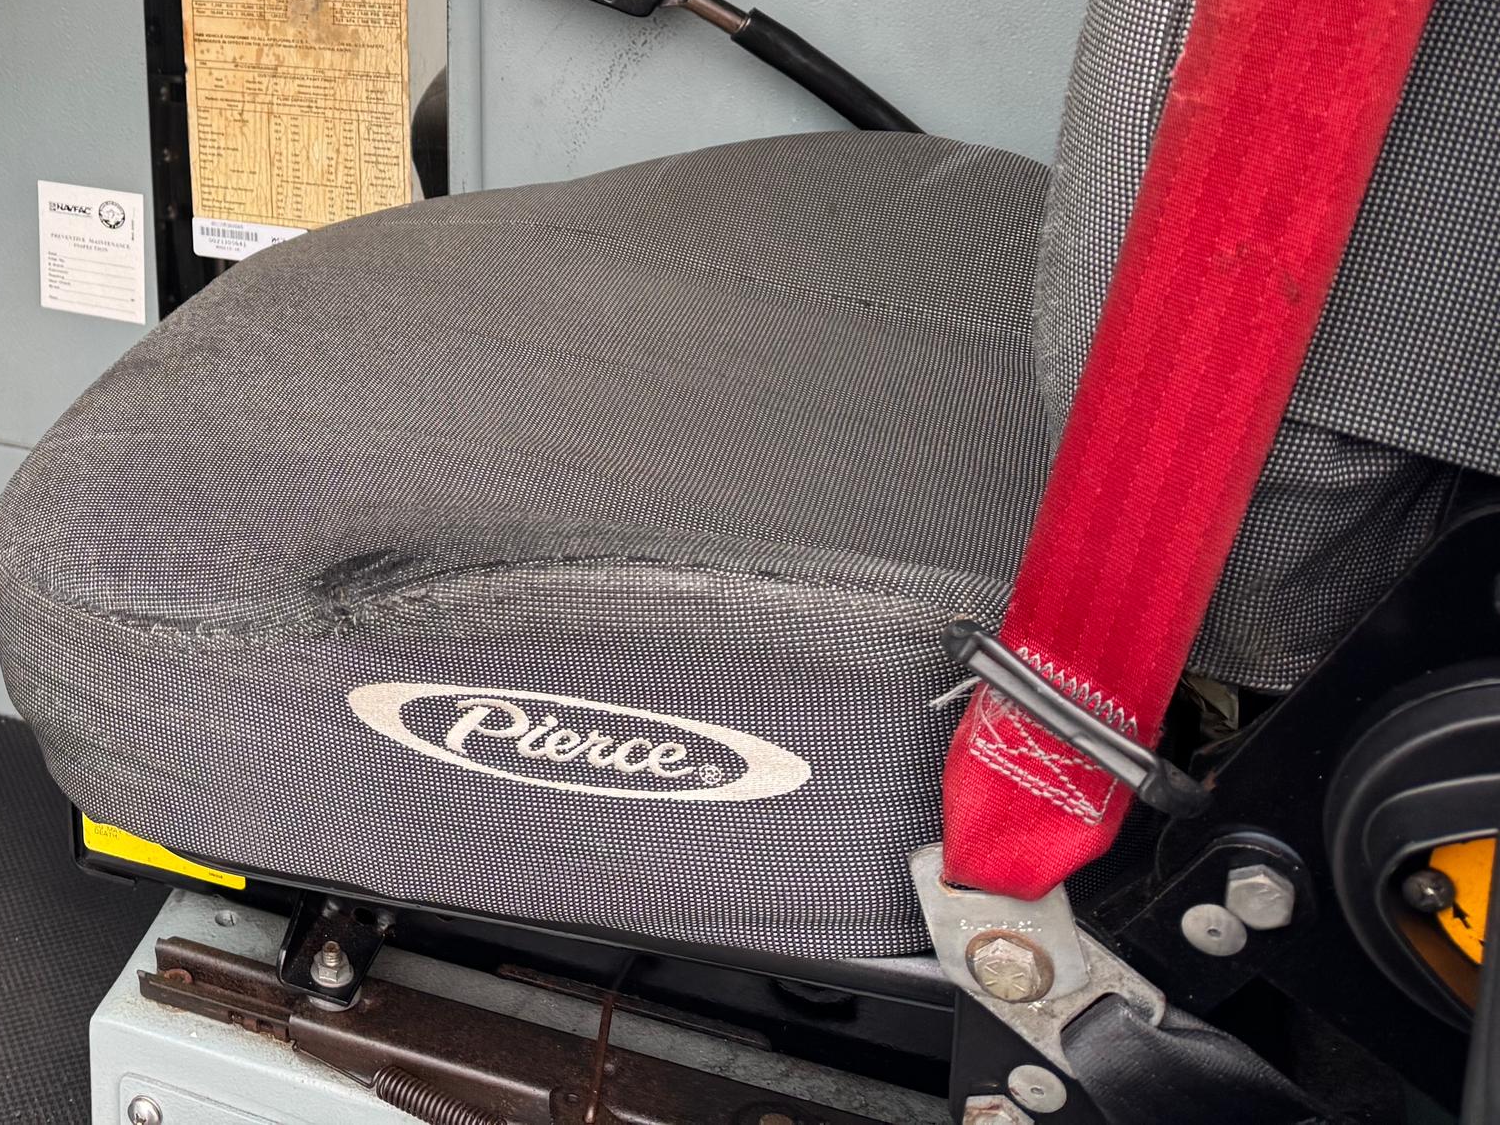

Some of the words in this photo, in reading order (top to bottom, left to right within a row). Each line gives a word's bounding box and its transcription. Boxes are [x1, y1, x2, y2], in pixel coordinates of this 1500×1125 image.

[50, 232, 87, 243] PREVENTIVE
[88, 237, 132, 250] MAINTENANCE
[73, 242, 109, 253] INSPECTION
[445, 697, 697, 779] Pierce
